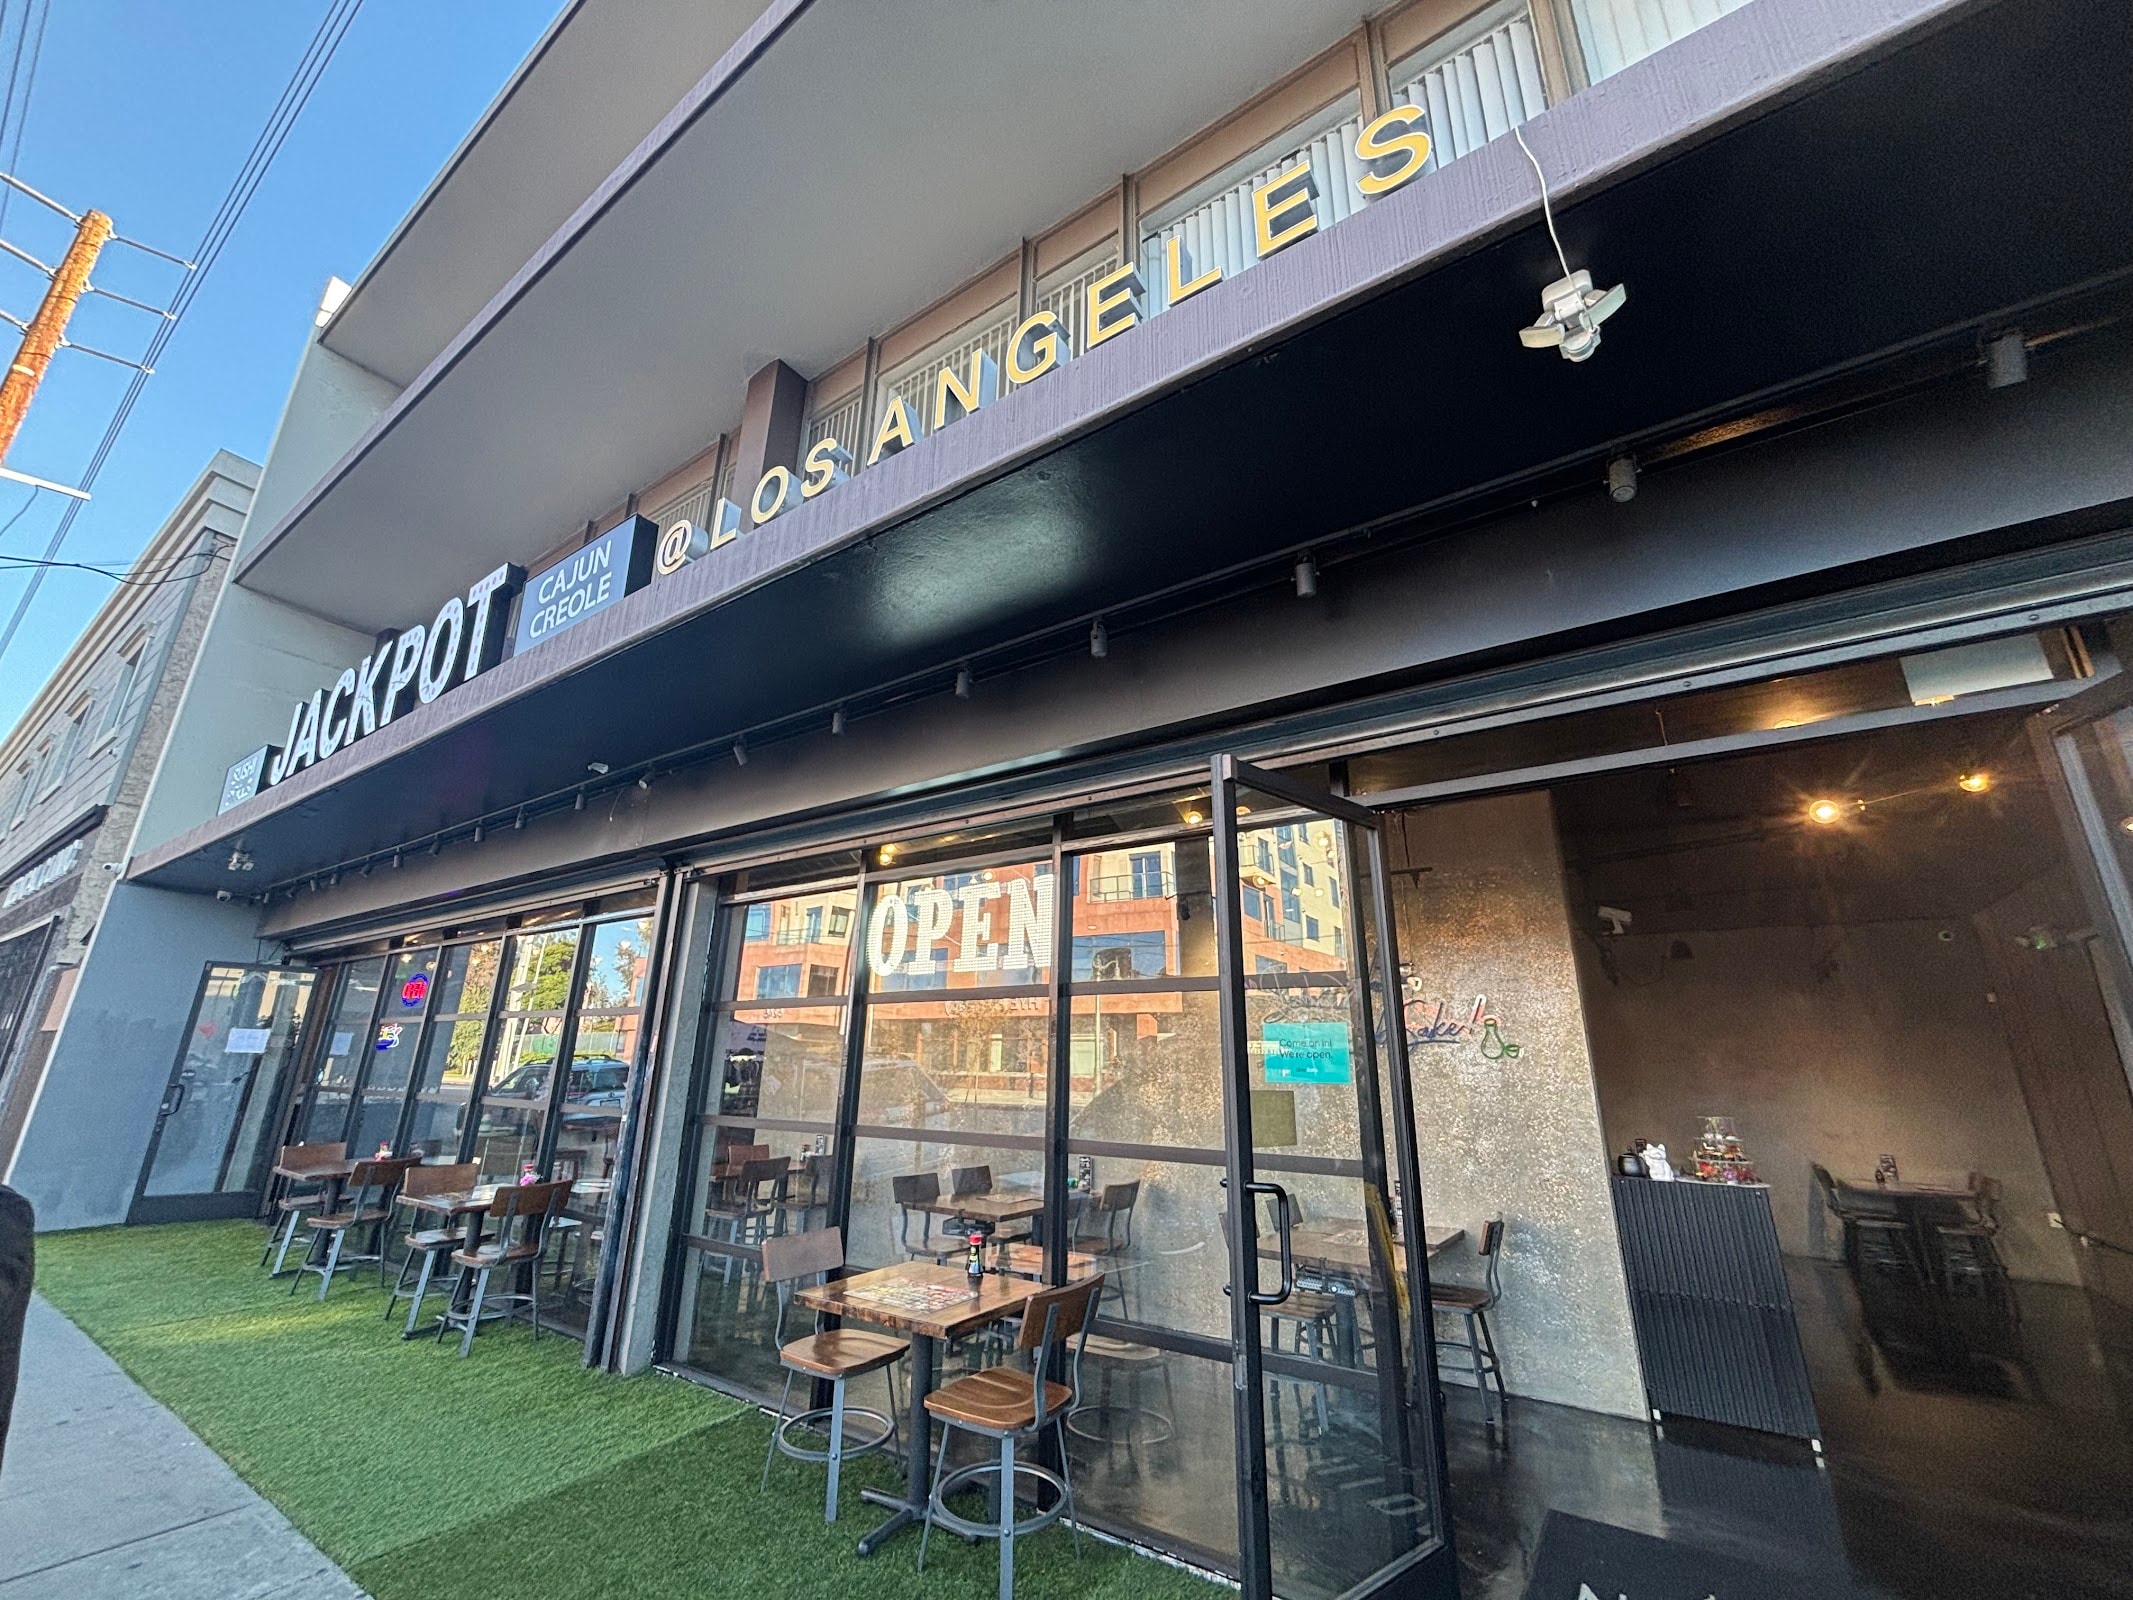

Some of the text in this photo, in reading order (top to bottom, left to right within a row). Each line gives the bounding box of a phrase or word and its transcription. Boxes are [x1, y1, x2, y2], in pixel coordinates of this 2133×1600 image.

[866, 104, 1434, 467] ANGELES
[529, 571, 613, 639] CREOLE
[538, 539, 612, 605] CAJUN
[269, 562, 509, 785] JACKPOT
[867, 873, 1054, 977] OPEN
[1279, 1038, 1307, 1048] Come
[1308, 1040, 1321, 1049] on
